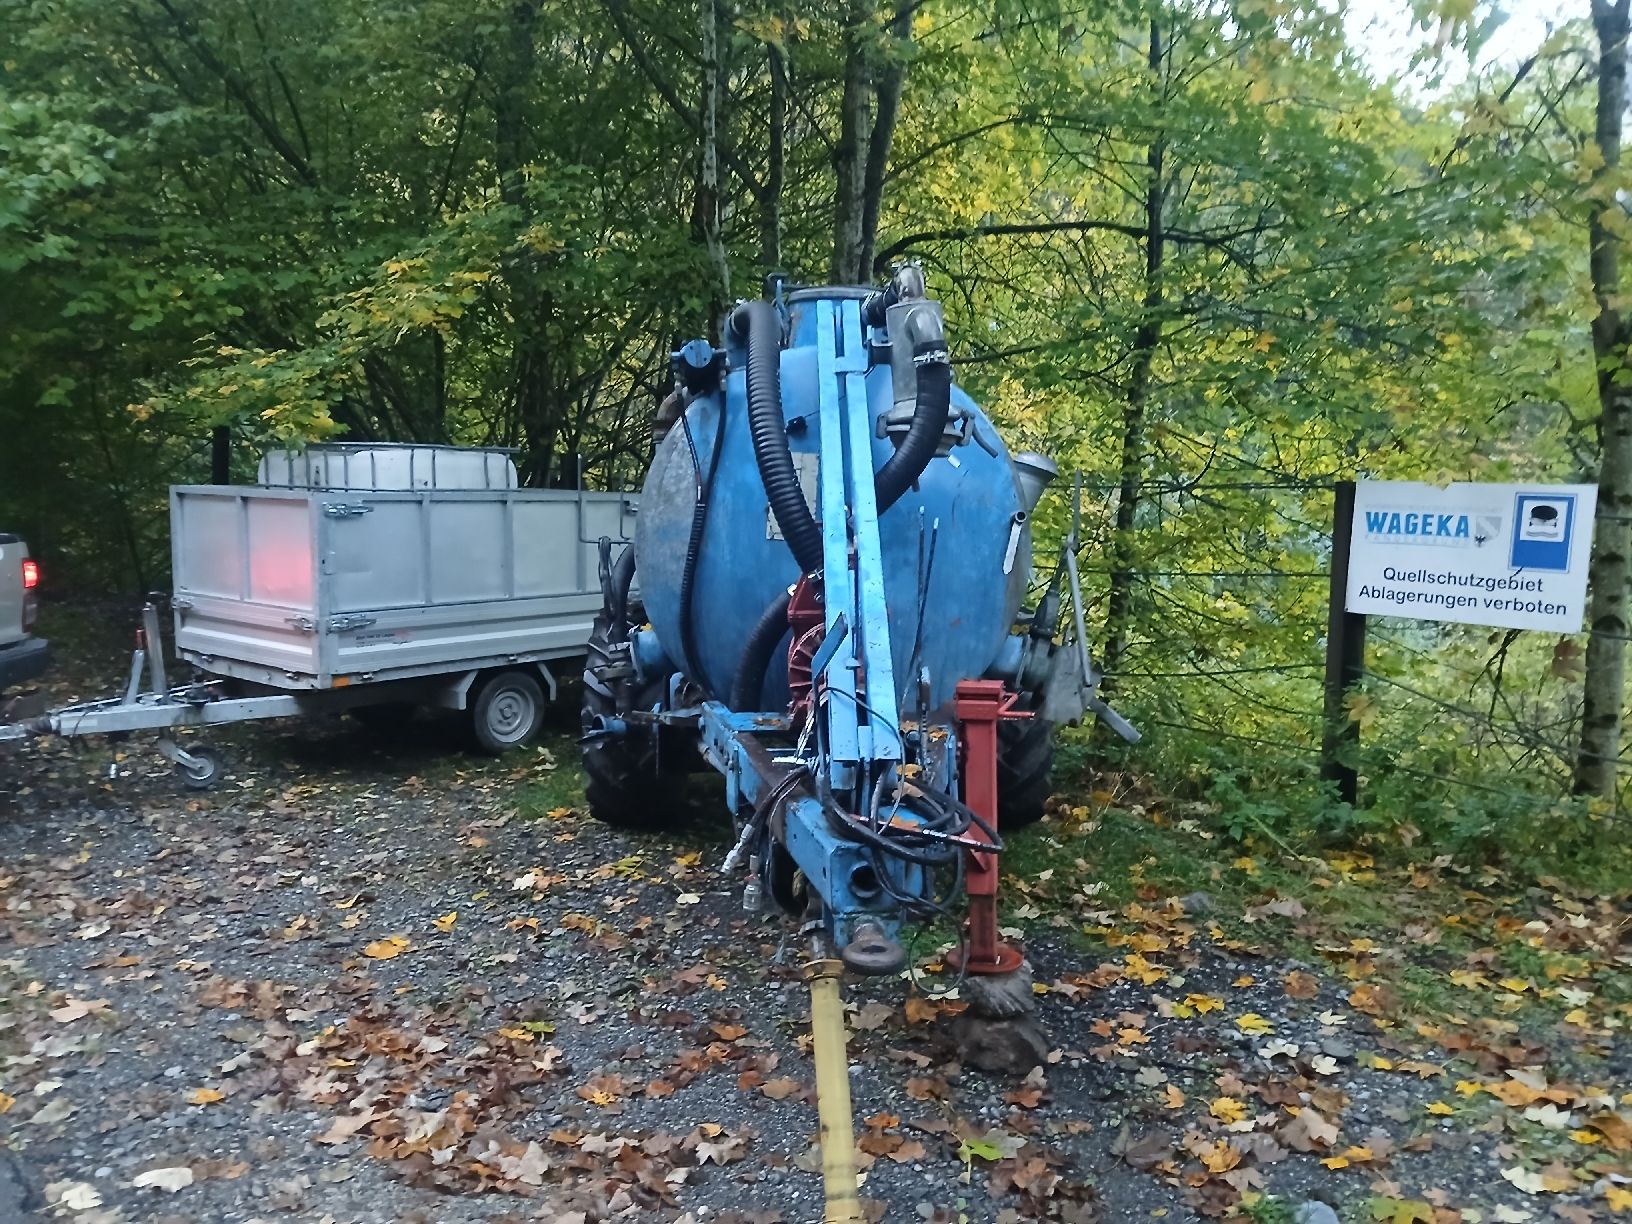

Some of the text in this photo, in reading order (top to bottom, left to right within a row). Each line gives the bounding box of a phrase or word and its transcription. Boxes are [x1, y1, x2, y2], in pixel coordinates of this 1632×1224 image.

[1365, 511, 1469, 538] WAGEKA
[1383, 567, 1544, 592] Quellschutzgebiet
[1359, 585, 1567, 615] Ablagerungen verboten
